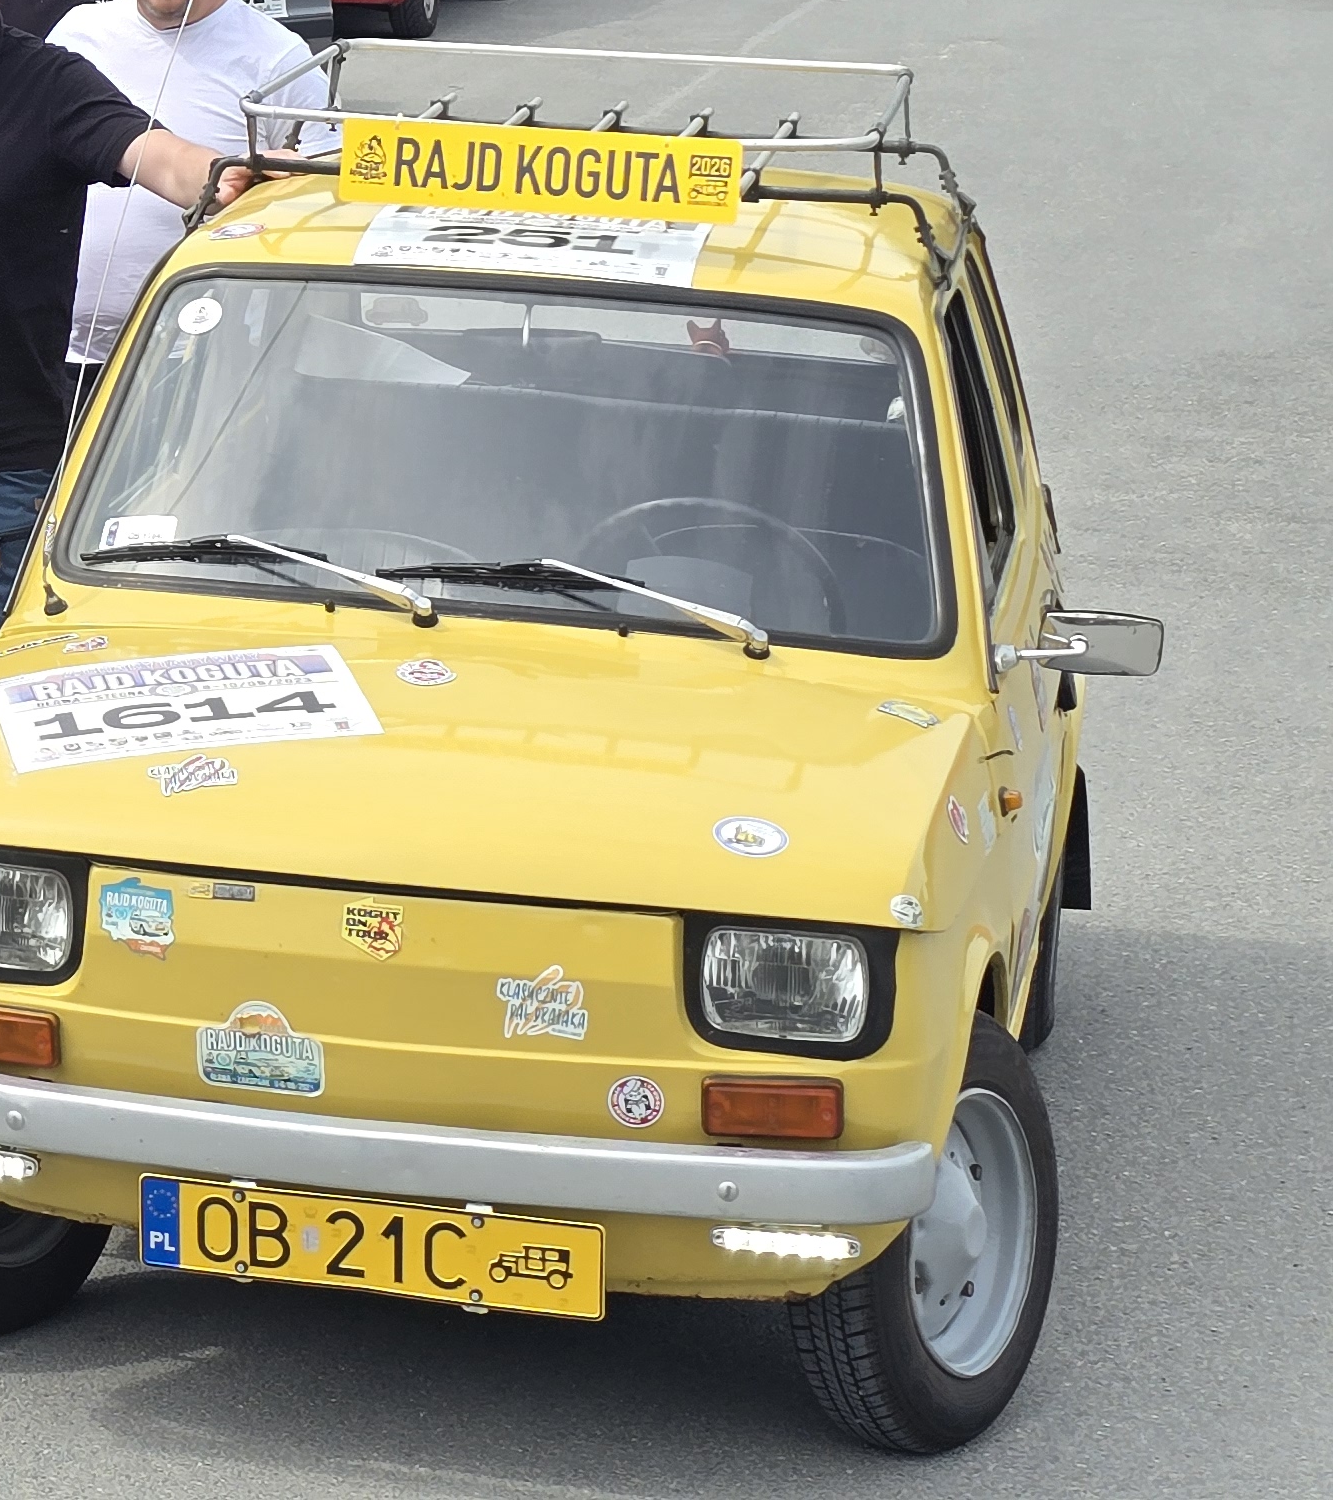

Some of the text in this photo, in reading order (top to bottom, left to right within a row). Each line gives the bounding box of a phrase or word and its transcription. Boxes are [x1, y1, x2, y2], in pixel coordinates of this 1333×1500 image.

[393, 136, 731, 204] RAJD KOGUTA 2026
[422, 224, 635, 254] 251
[32, 672, 136, 701] RAJD
[139, 657, 308, 686] KOGUTA
[35, 690, 337, 740] 1614
[106, 891, 130, 907] RAJD
[131, 895, 167, 913] KOGUTA
[346, 906, 400, 921] KOGUT
[346, 917, 367, 927] ON
[206, 1028, 314, 1061] RAJD KOGUTA
[150, 1196, 467, 1289] PL OB 21C
